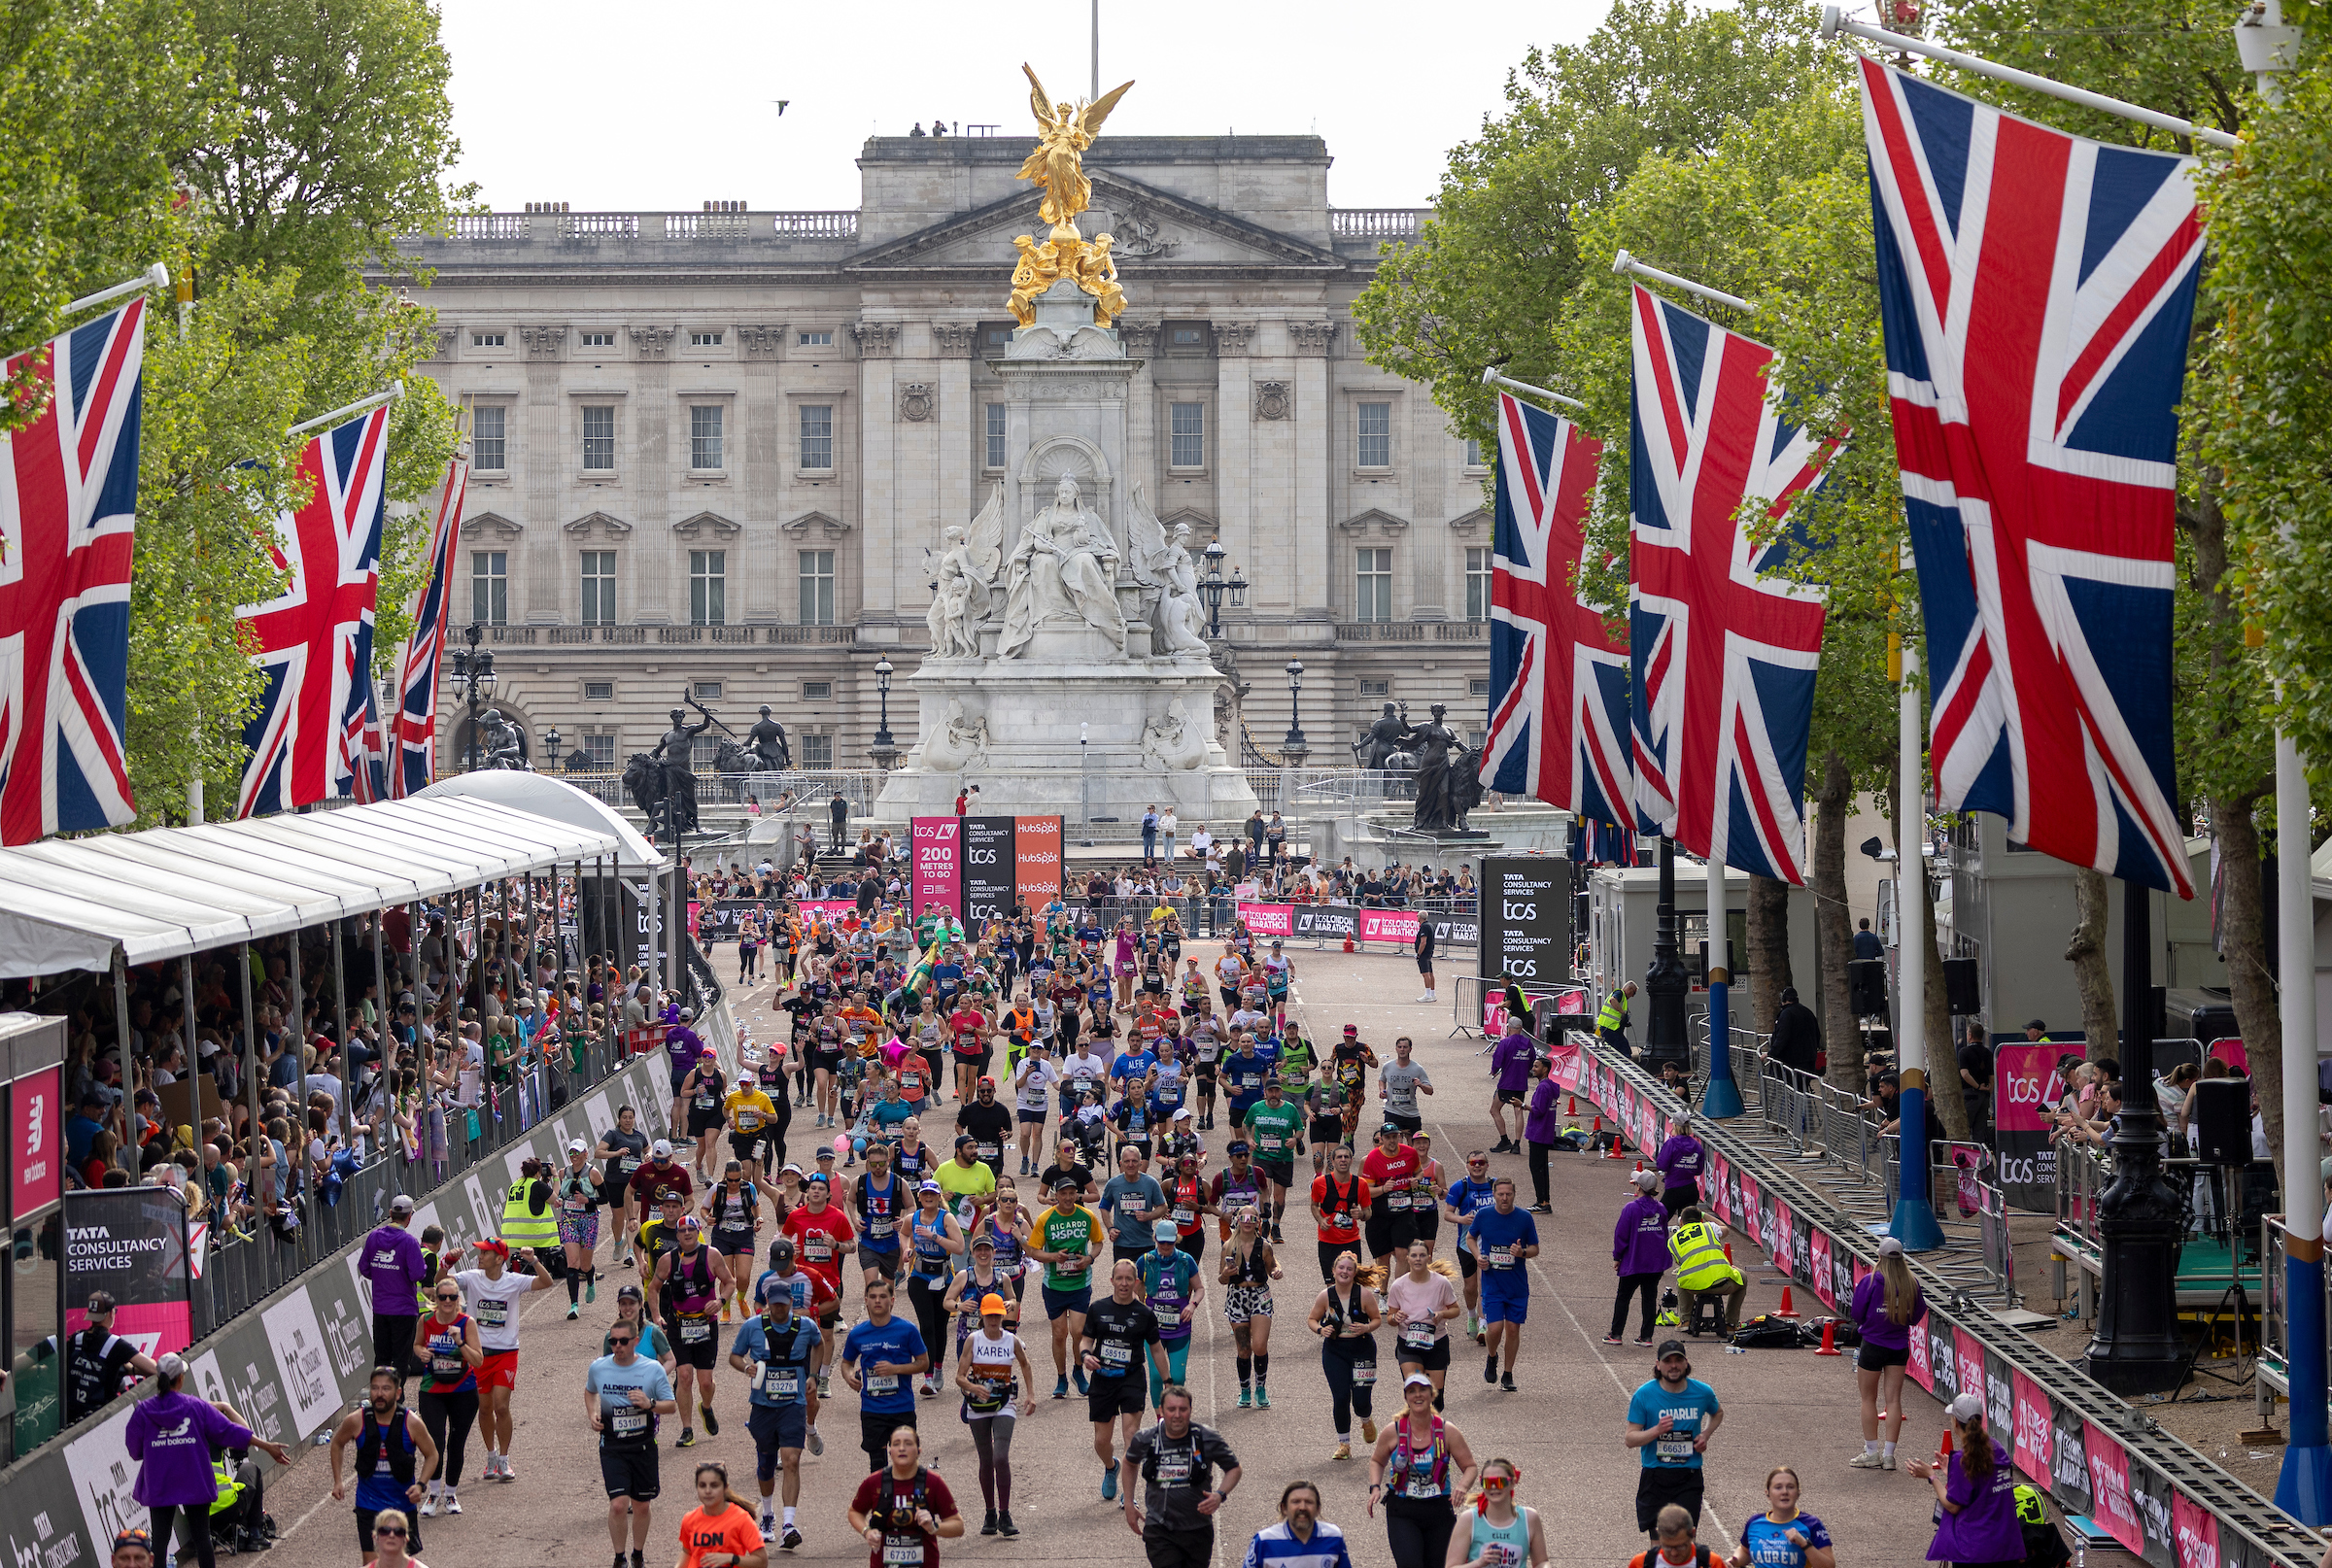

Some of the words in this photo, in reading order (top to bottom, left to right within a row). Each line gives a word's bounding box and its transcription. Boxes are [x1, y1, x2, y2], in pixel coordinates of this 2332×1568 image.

[1037, 700, 1092, 710] VICTORIA
[914, 824, 934, 837] tcs
[1018, 822, 1058, 834] HubSpot
[921, 847, 952, 861] 200
[969, 845, 996, 864] tcs
[1018, 851, 1058, 864] HubSpot
[1018, 881, 1058, 894] HubSpot
[1503, 898, 1537, 920] tcs
[1315, 923, 1354, 934] MARATHON
[1503, 955, 1537, 977] tcs
[1128, 1059, 1145, 1069] ALFIE
[2007, 1071, 2040, 1103] tcs
[32, 1160, 46, 1182] balance
[1387, 1160, 1406, 1170] JACOB
[2000, 1151, 2033, 1184] tcs
[1050, 1221, 1087, 1231] RICARDO
[67, 1226, 110, 1240] TATA
[1052, 1229, 1087, 1240] NSPCC
[67, 1238, 167, 1256] CONSULTANCY
[69, 1255, 132, 1272] SERVICES
[1109, 1323, 1126, 1333] TREV
[322, 1310, 353, 1378] tcs
[429, 1334, 454, 1345] HAYLEY
[977, 1345, 1011, 1357] KAREN
[280, 1342, 312, 1412] tcs
[771, 1382, 793, 1391] 53279
[1659, 1407, 1698, 1420] CHARLIE
[618, 1418, 641, 1428] 53101
[152, 1438, 166, 1448] new
[167, 1437, 196, 1446] balance
[1663, 1444, 1687, 1453] 66631
[1414, 1454, 1432, 1464] SAM
[33, 1510, 54, 1541] TATA
[693, 1532, 724, 1547] LDN
[890, 1549, 917, 1560] 67370
[1751, 1551, 1798, 1566] LAUREN
